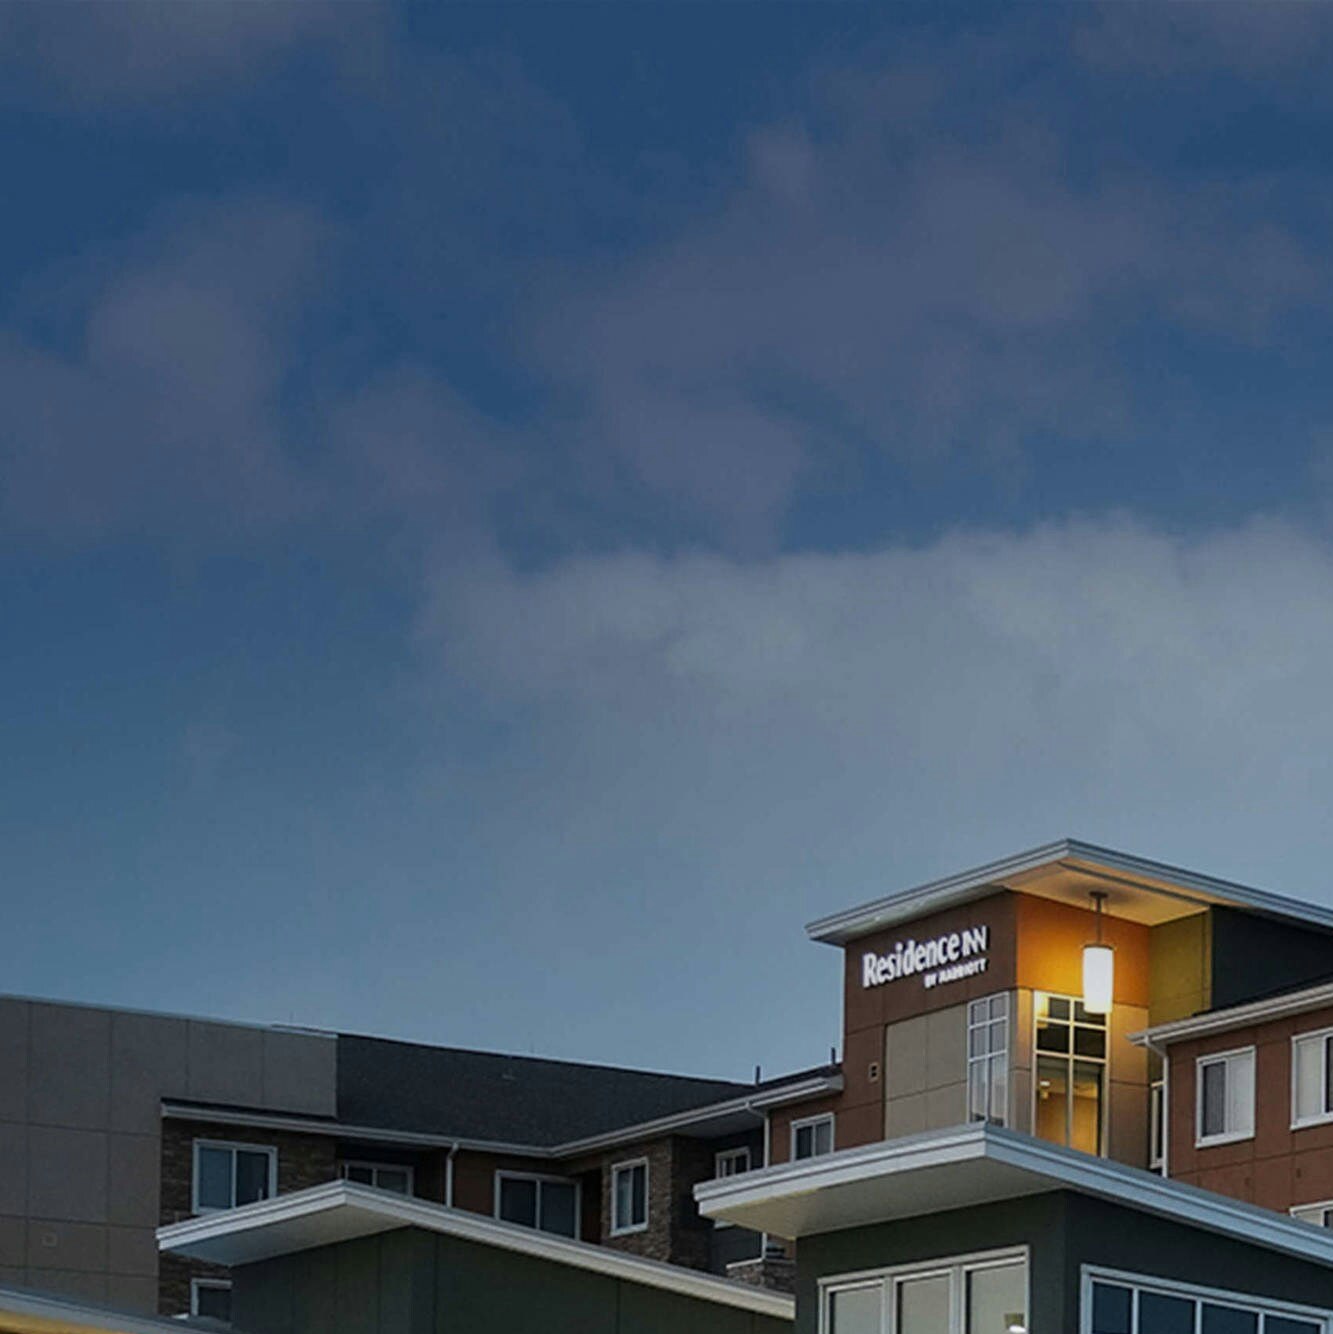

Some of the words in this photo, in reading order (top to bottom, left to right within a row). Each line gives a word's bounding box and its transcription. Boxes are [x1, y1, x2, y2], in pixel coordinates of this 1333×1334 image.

[862, 932, 961, 988] Residence
[961, 925, 988, 957] INN
[938, 957, 987, 984] MARRIOTT
